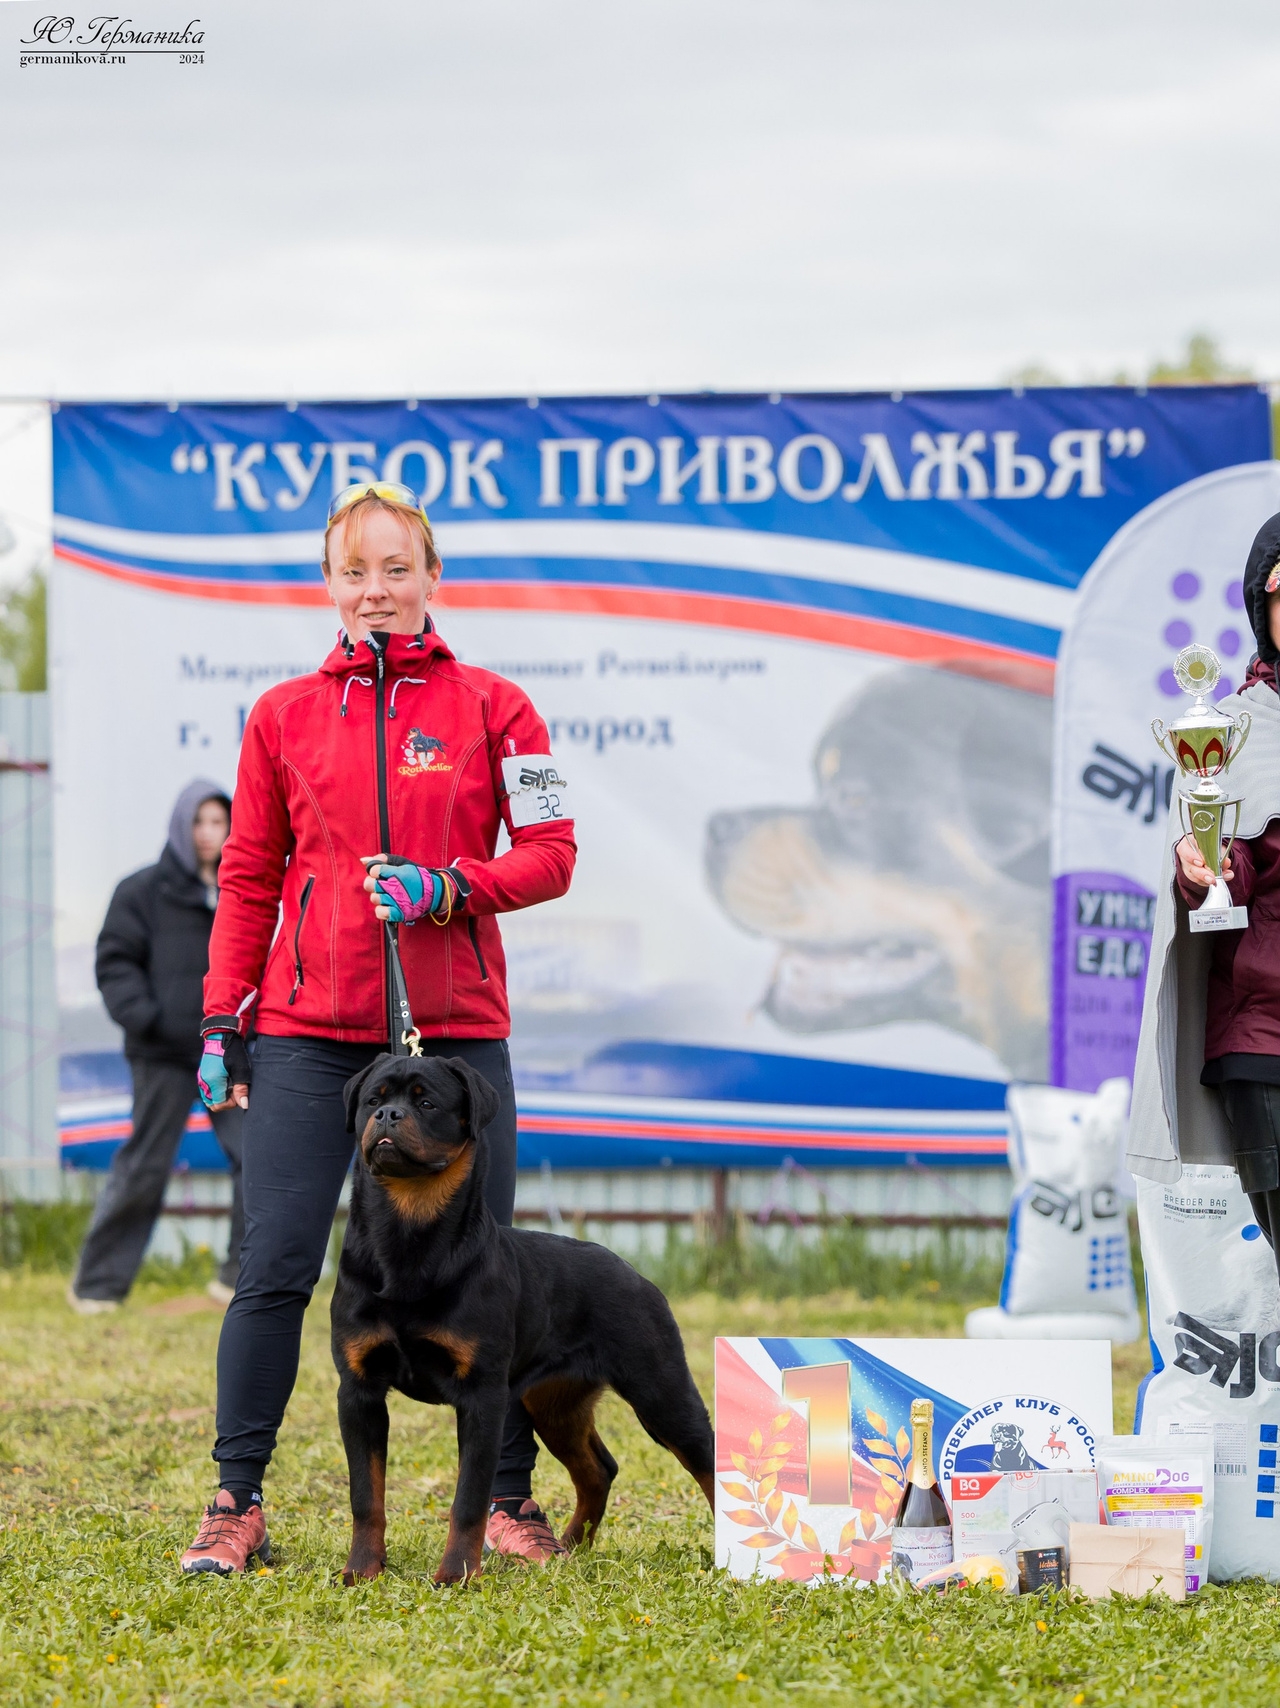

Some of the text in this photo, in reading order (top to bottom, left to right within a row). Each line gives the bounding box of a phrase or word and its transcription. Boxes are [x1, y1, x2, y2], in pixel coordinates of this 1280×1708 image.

[398, 763, 453, 776] Rottweiler
[537, 794, 563, 819] 32
[1164, 1194, 1227, 1207] BREEDER BAG
[782, 1361, 853, 1507] 1
[943, 1401, 1004, 1480] РОТВЕЙЛЕР
[1015, 1398, 1061, 1416] КЛУБ
[960, 1479, 980, 1491] BQ
